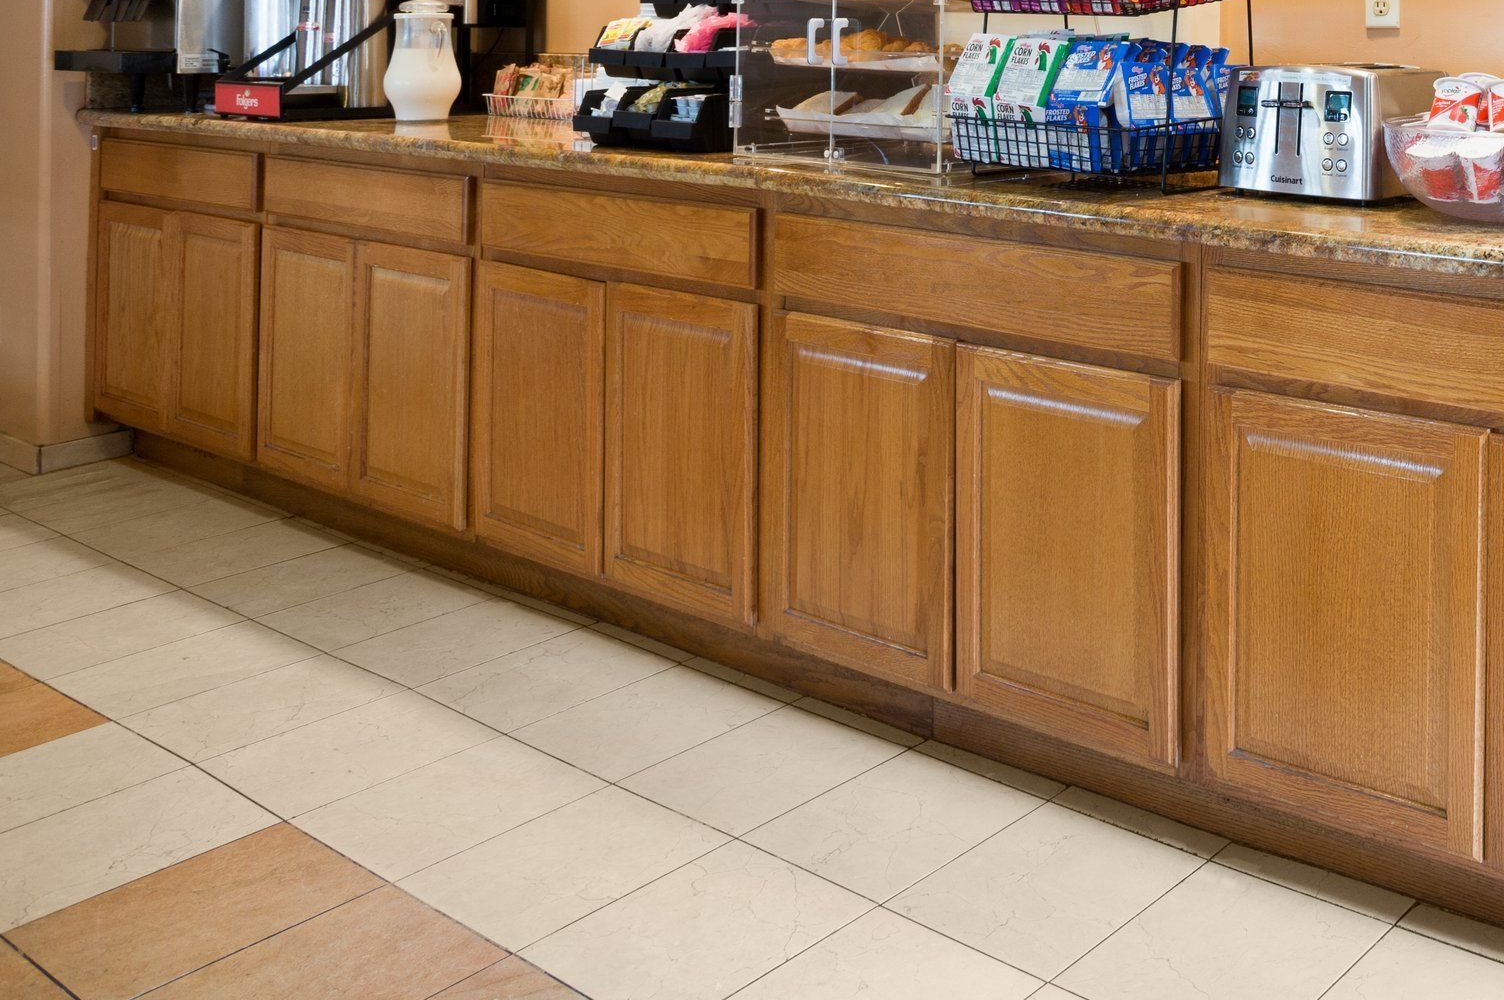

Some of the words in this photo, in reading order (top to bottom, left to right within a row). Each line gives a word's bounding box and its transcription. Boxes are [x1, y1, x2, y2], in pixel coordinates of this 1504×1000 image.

[966, 43, 983, 52] CORN
[1014, 46, 1033, 57] CORN
[1010, 56, 1029, 65] FLAKES
[236, 94, 259, 110] Folgers
[951, 102, 969, 112] CORN
[996, 104, 1014, 114] CORN
[1045, 108, 1071, 116] FROSTED
[1046, 114, 1068, 122] FLAKES
[1270, 174, 1303, 185] Cuisinart
